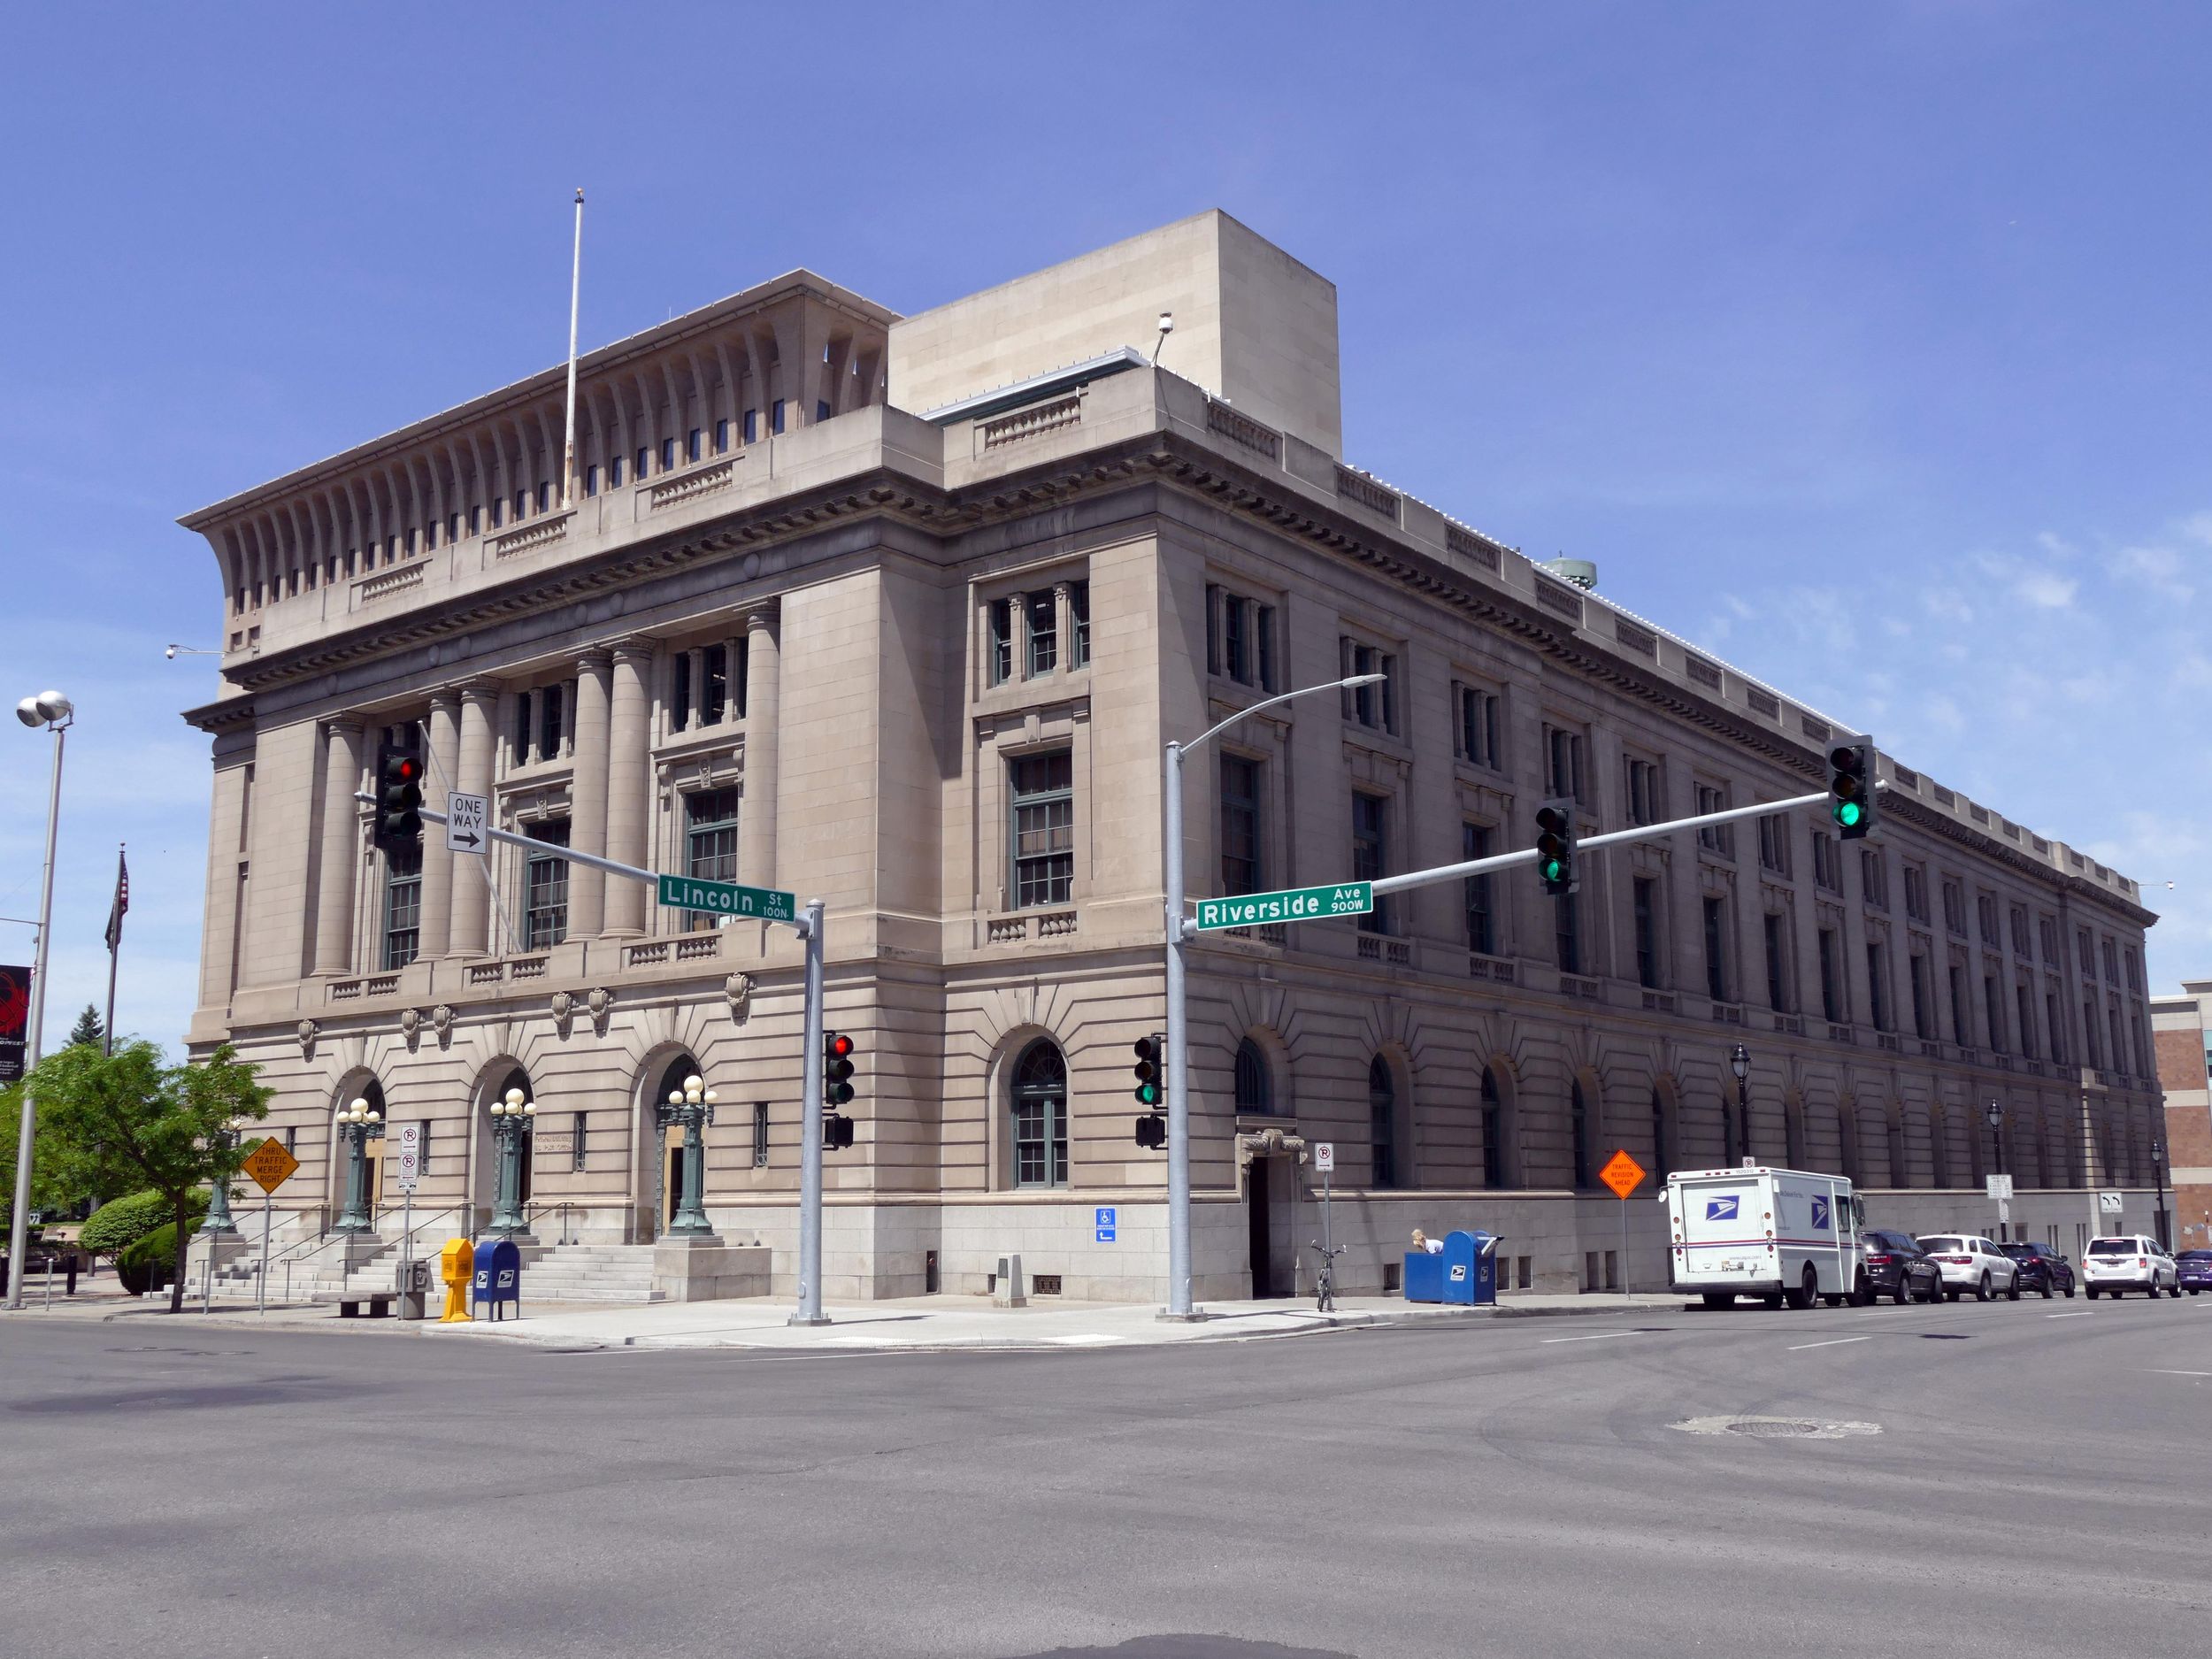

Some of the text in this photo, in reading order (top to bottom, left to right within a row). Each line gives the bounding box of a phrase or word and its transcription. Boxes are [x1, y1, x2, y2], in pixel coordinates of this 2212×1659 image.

[455, 798, 481, 814] ONE
[454, 813, 482, 829] WAY
[667, 880, 782, 912] Lincoln St
[763, 906, 787, 919] 100N
[1204, 888, 1361, 925] Riverside Ave
[1331, 899, 1364, 913] 900W
[262, 1147, 281, 1156] THRU
[254, 1156, 288, 1165] TRAFFIC
[257, 1165, 283, 1174] MERGE
[259, 1174, 281, 1183] RIGHT
